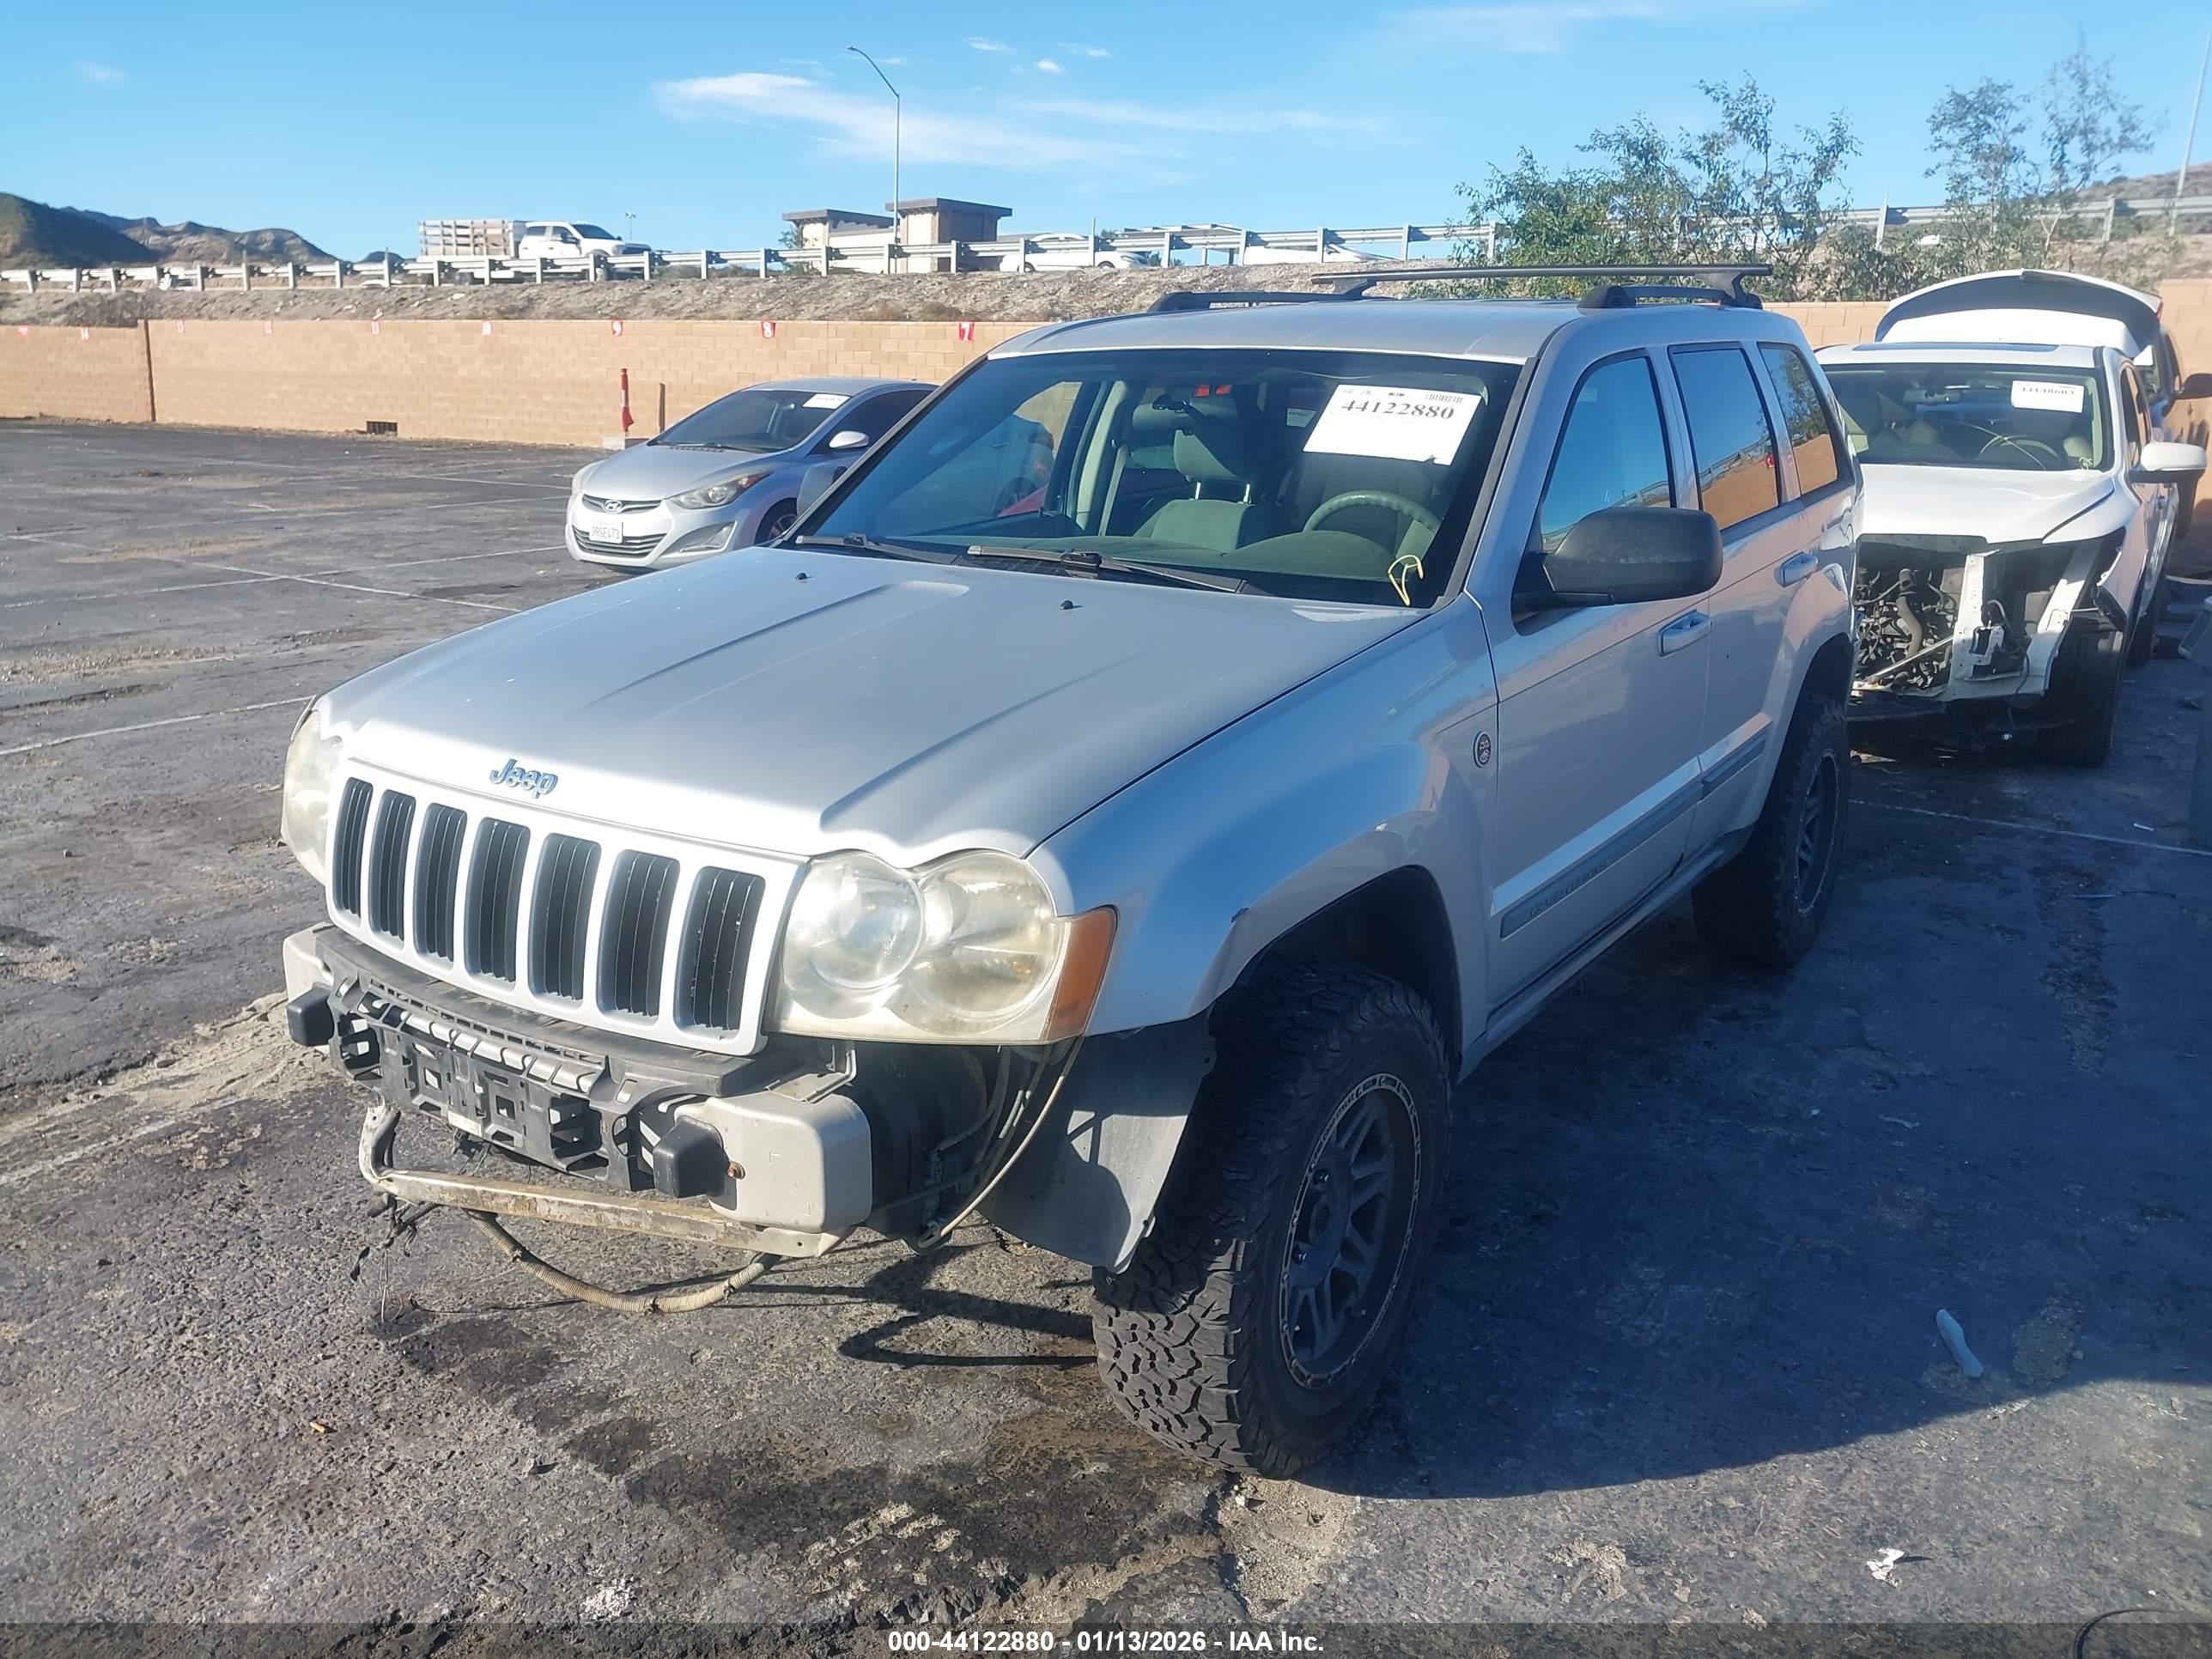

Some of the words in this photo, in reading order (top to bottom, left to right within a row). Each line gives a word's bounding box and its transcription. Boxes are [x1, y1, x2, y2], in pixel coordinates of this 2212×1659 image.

[762, 321, 772, 337] 8
[961, 322, 971, 341] 7
[1341, 400, 1455, 420] 44122880
[489, 758, 559, 799] Jeep
